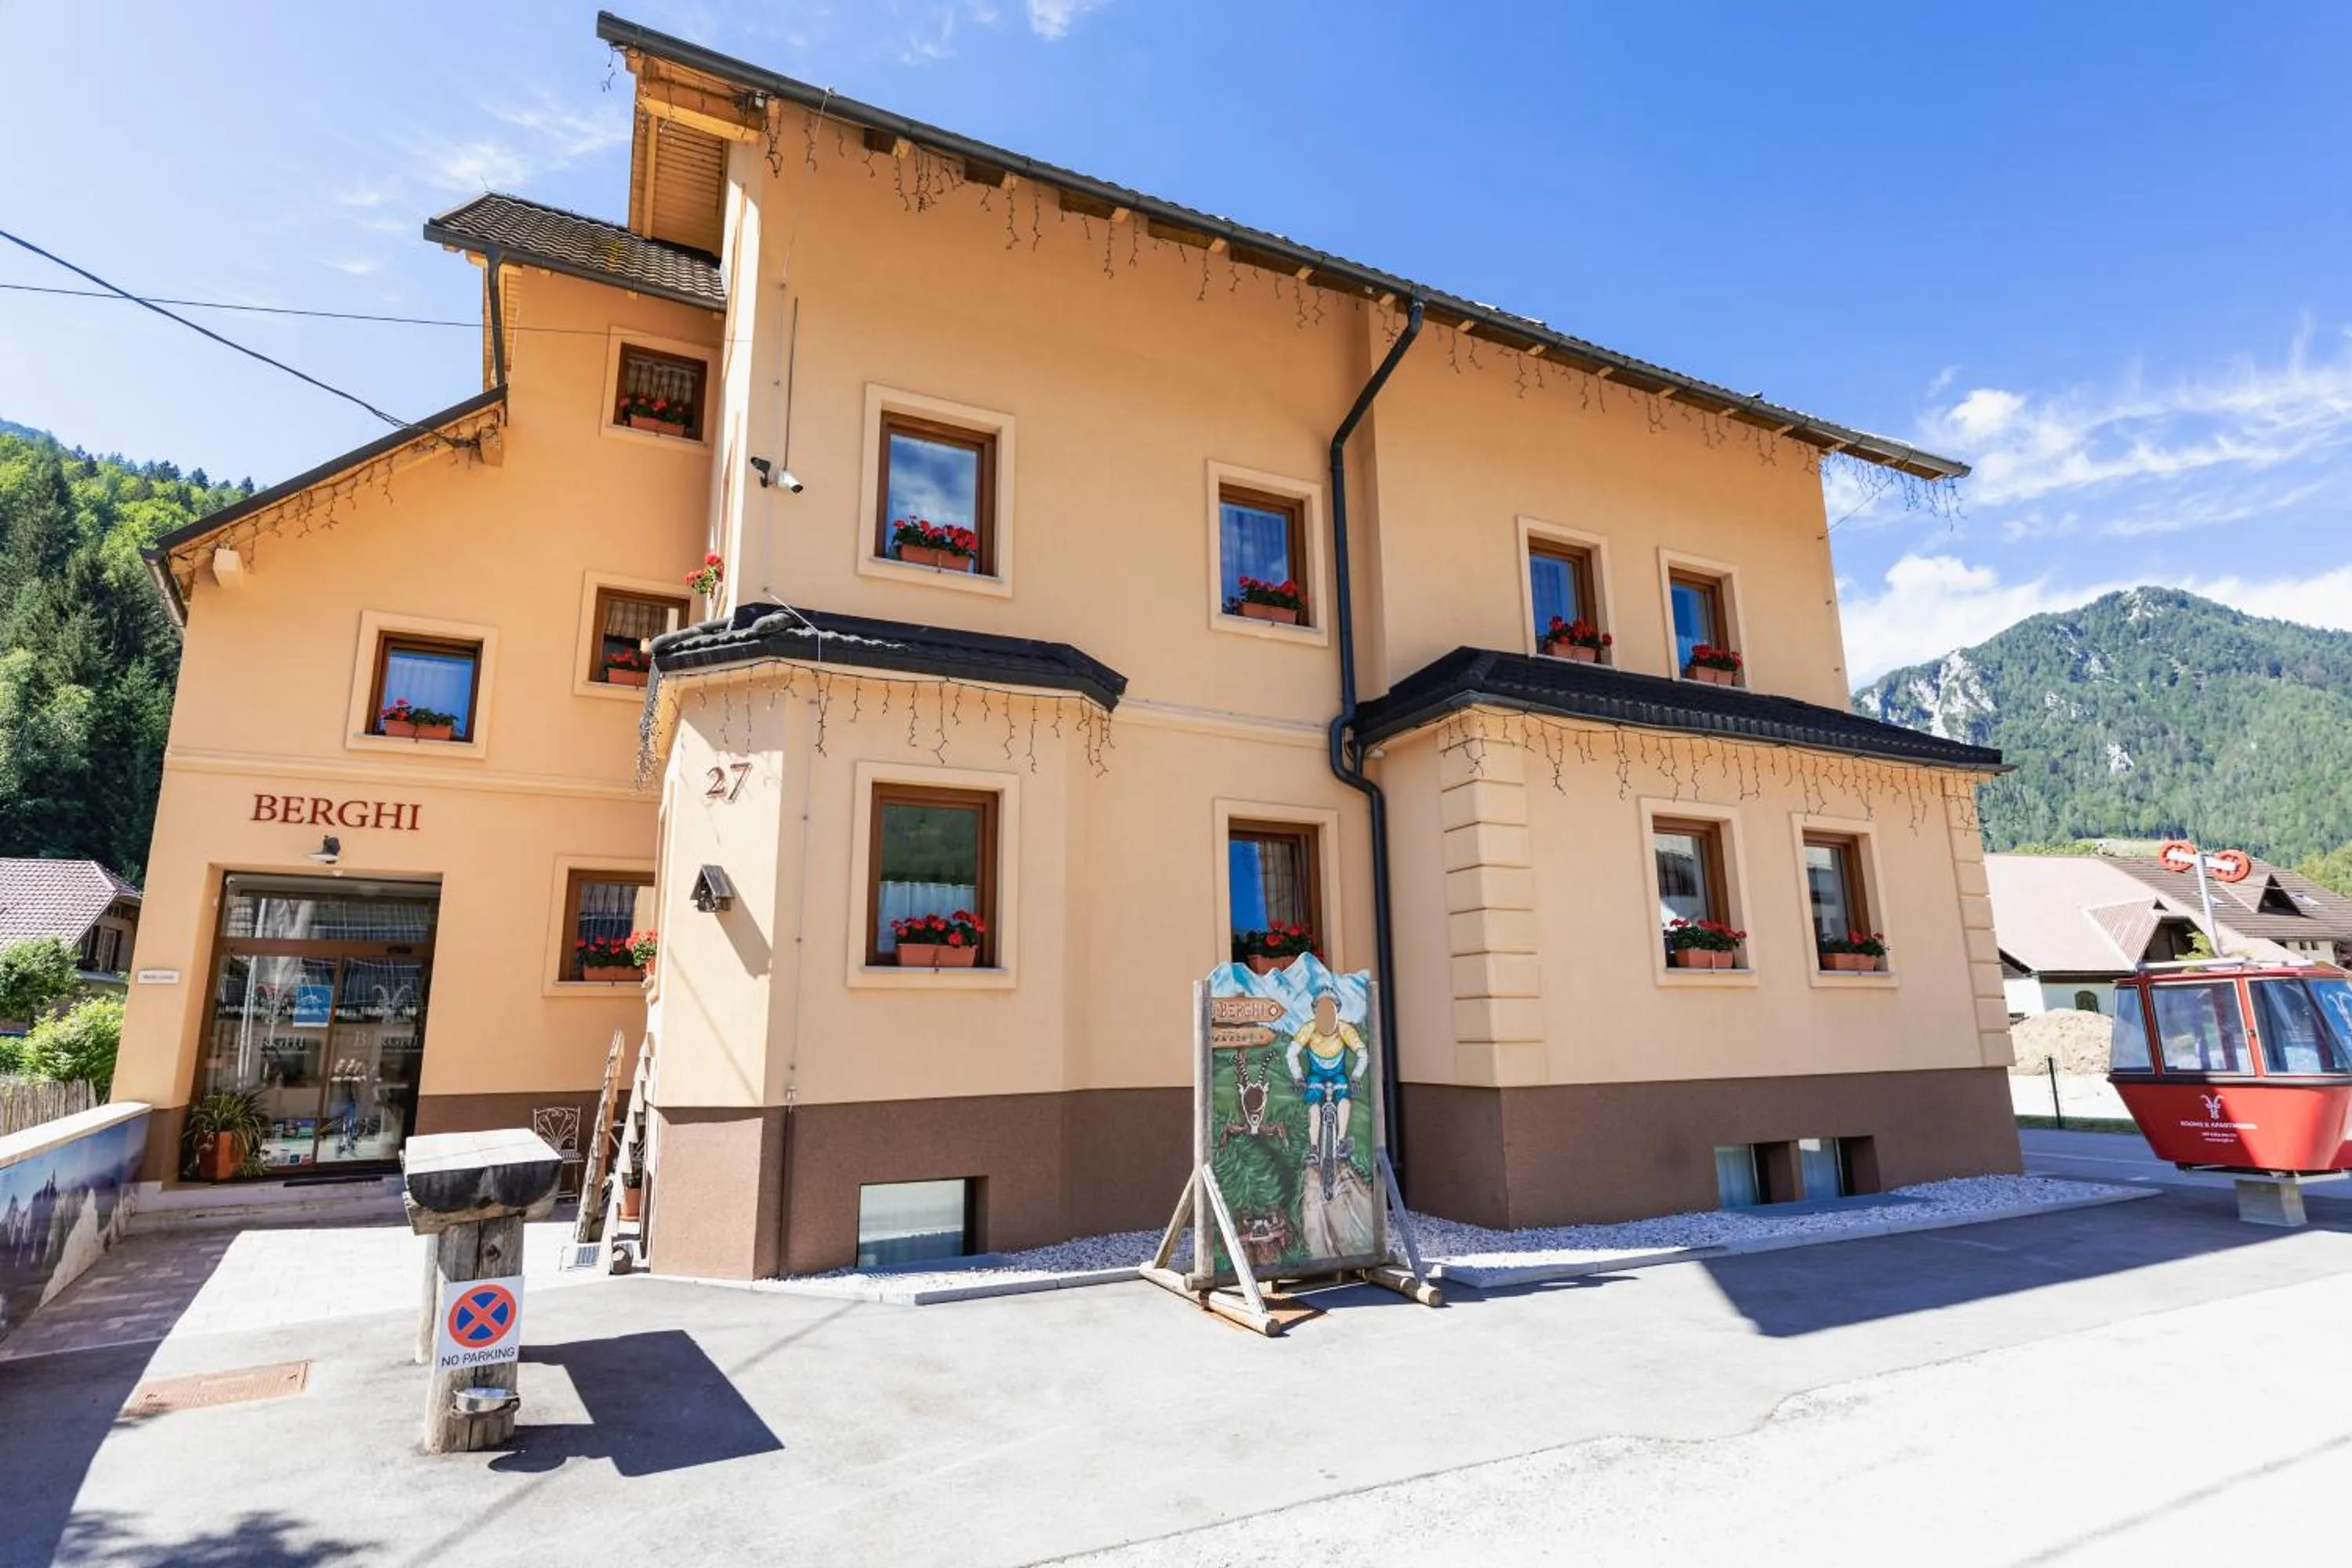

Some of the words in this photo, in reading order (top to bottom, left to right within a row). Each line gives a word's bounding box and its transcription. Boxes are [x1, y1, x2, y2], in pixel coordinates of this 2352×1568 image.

[705, 762, 753, 800] 27
[250, 793, 423, 830] BERGHI
[441, 1354, 459, 1367] NO
[463, 1346, 515, 1364] PARKING
